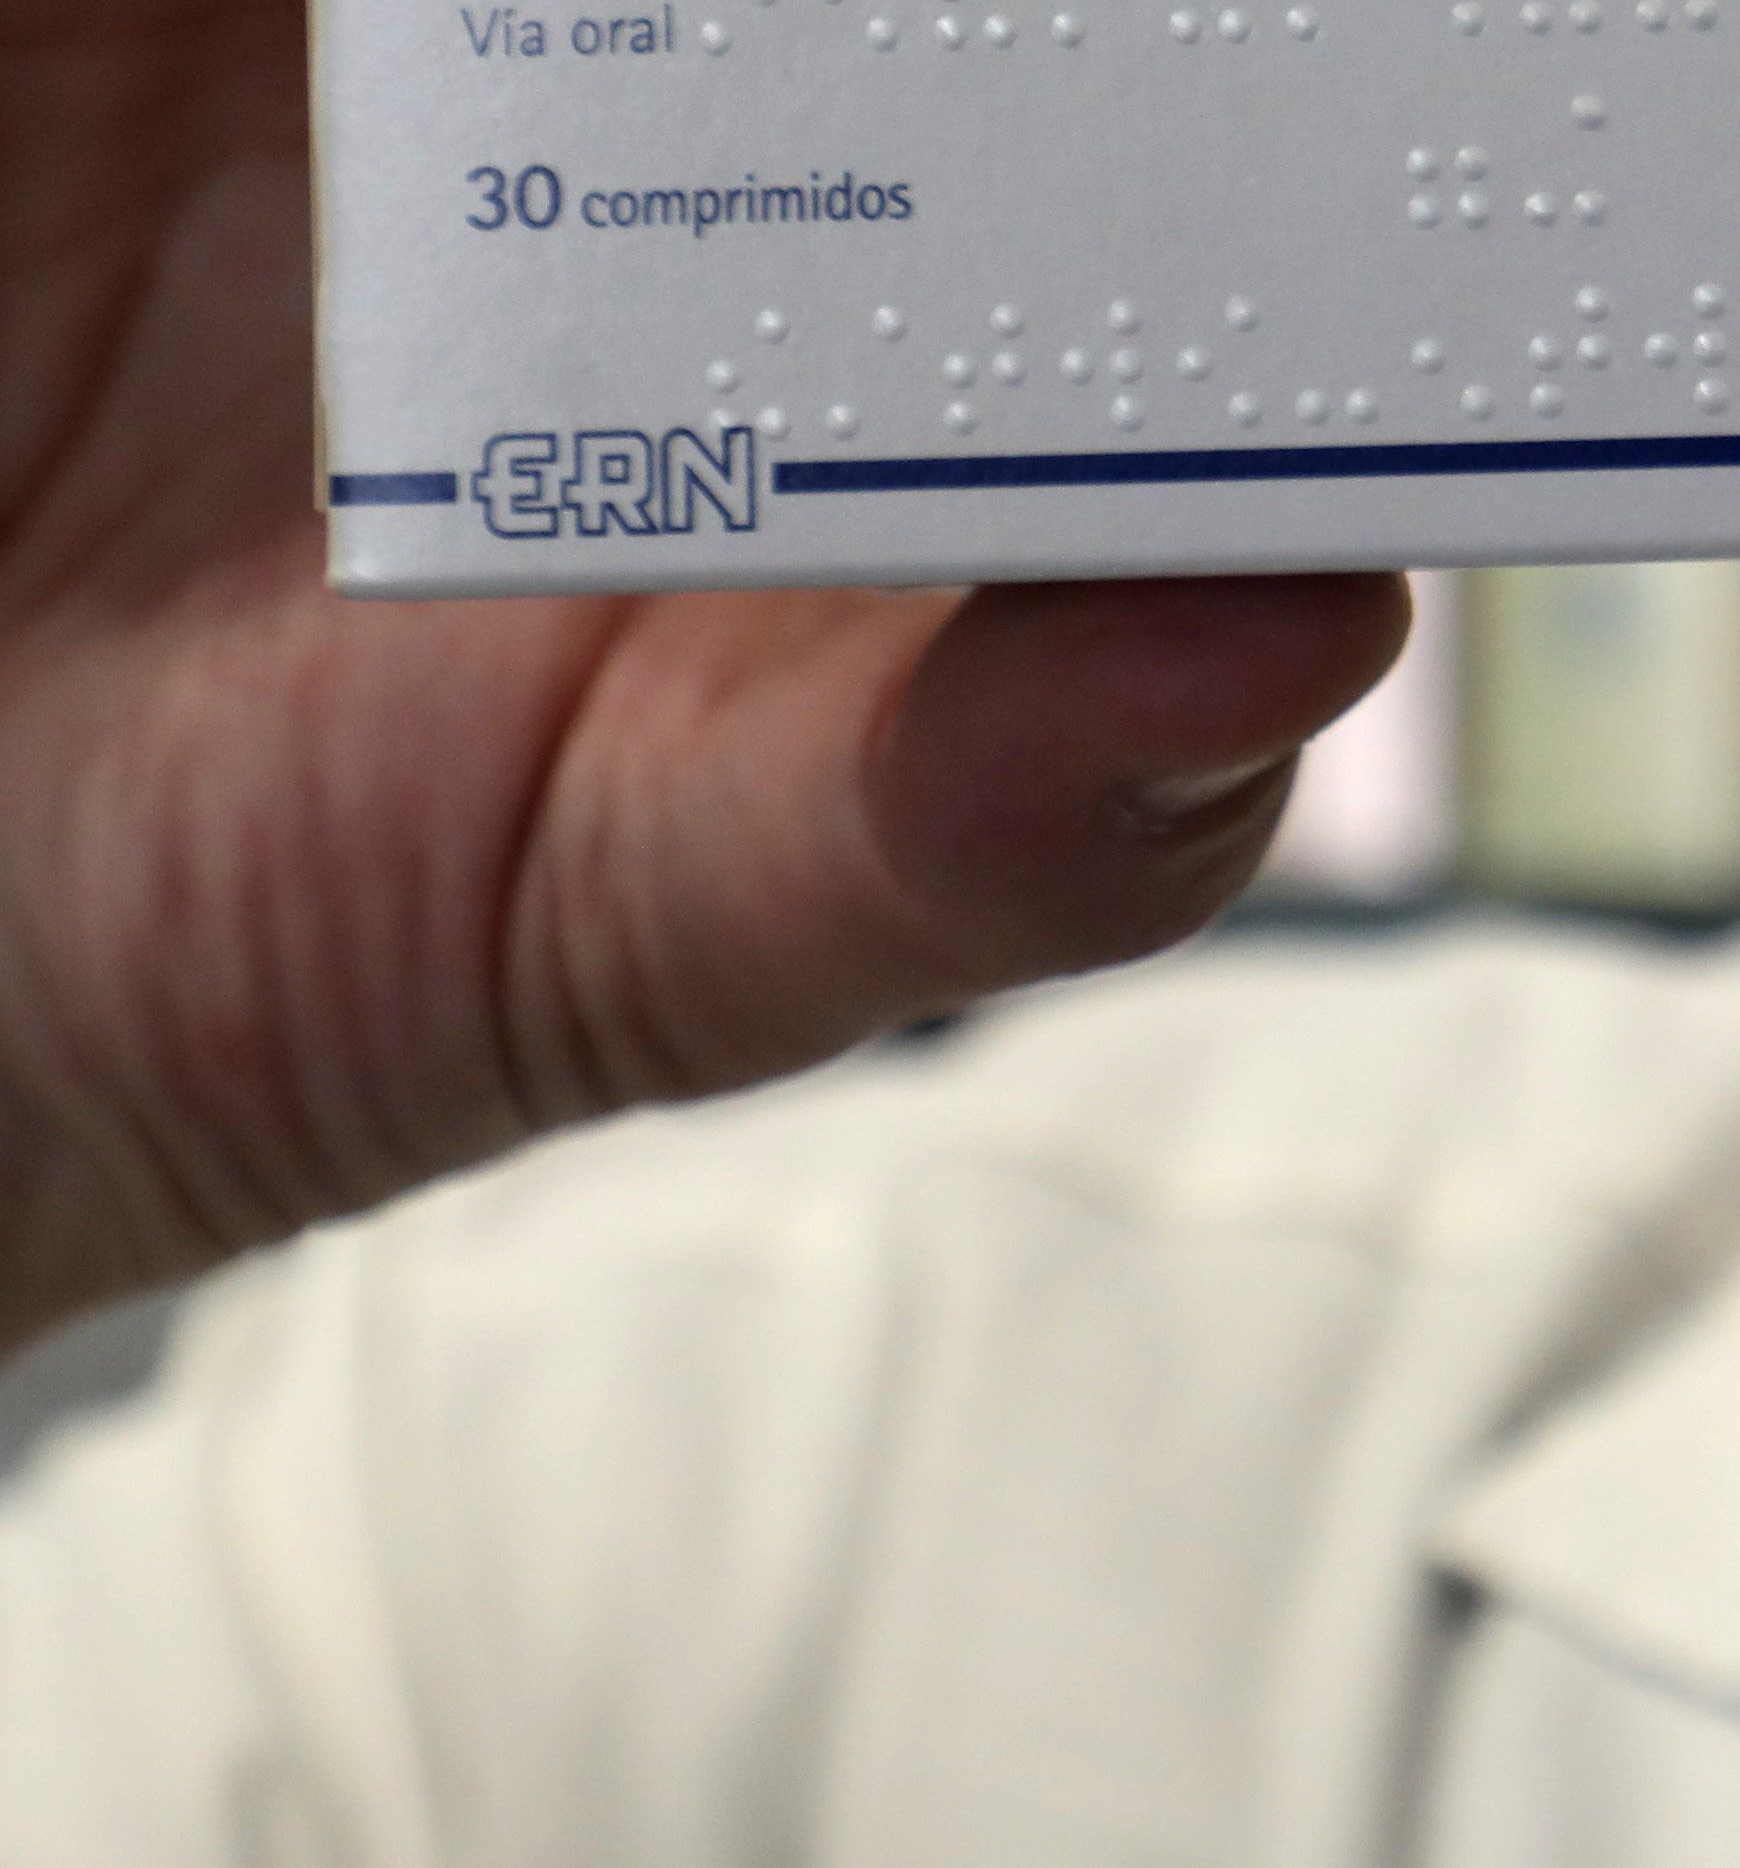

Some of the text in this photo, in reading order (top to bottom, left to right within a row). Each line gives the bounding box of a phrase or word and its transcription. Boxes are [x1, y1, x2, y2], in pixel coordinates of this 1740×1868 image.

[461, 8, 673, 58] Vía oral
[469, 164, 913, 238] 30 comprimidos
[472, 425, 757, 540] ERN
